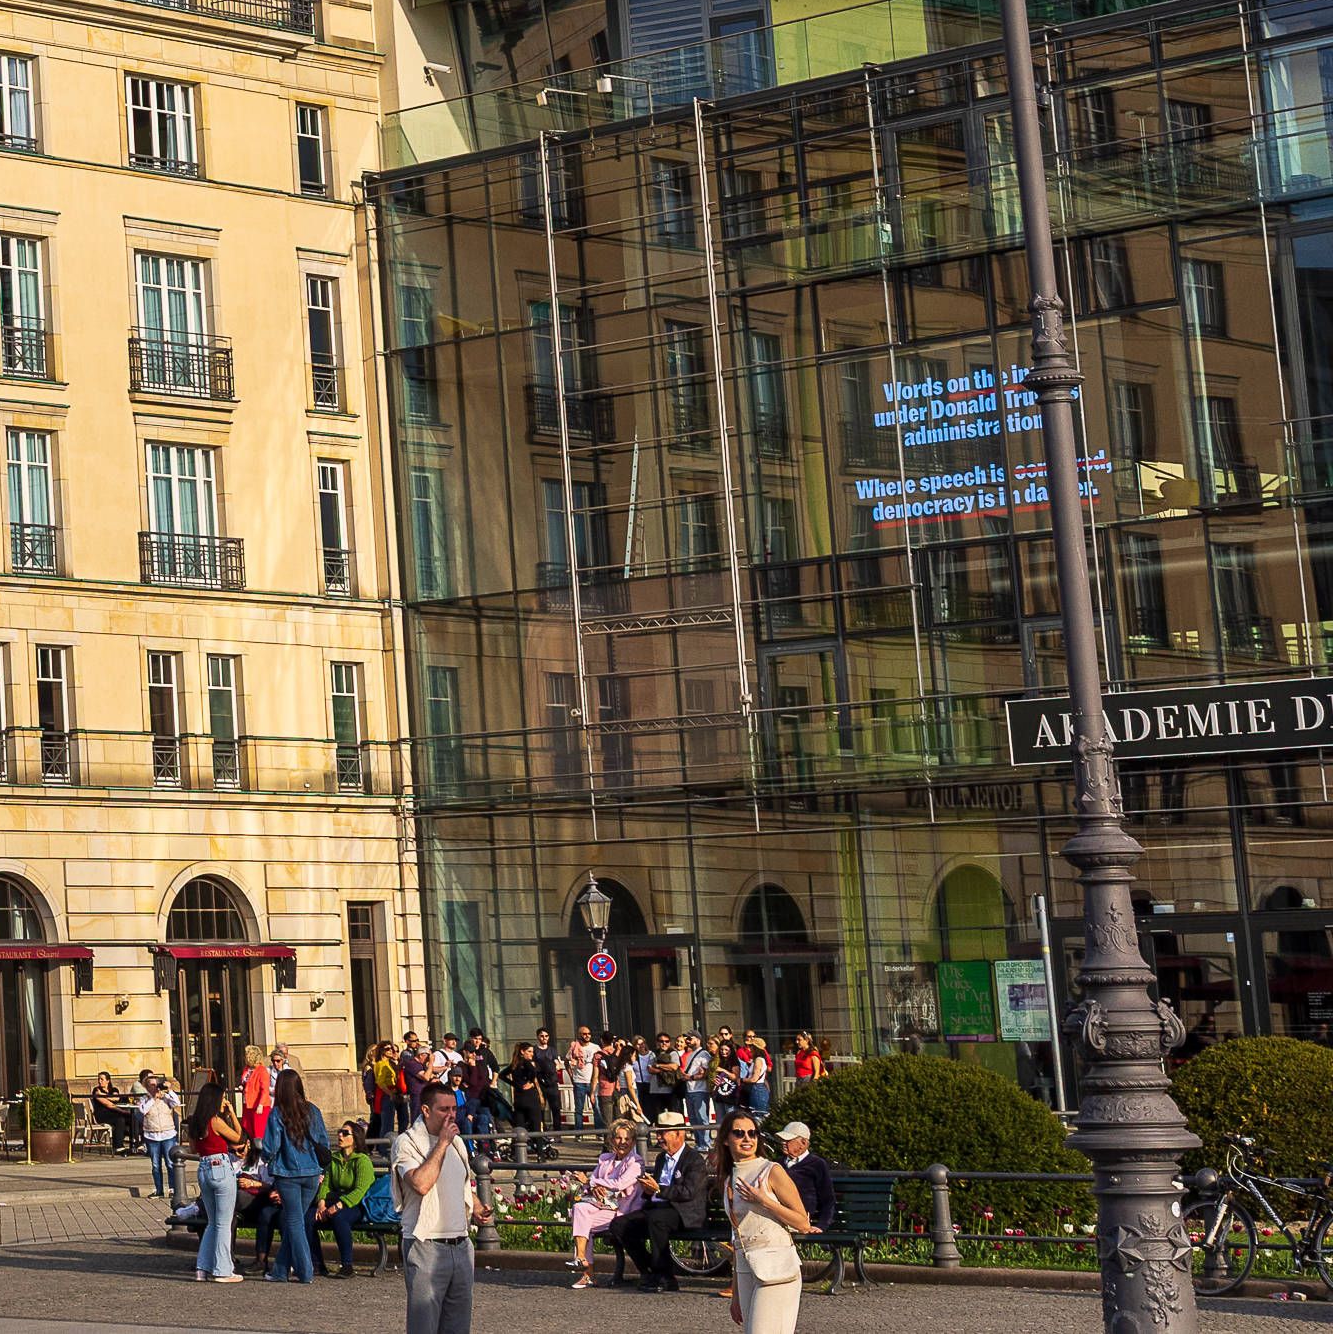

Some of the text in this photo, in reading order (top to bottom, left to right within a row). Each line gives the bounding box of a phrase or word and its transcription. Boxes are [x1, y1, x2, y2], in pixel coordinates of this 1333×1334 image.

[883, 376, 944, 402] Words
[948, 375, 970, 393] on
[874, 407, 927, 428] under
[930, 393, 996, 419] Donald
[855, 449, 1113, 500] Where speech is cenred,
[873, 479, 1099, 522] democracy is in daer.
